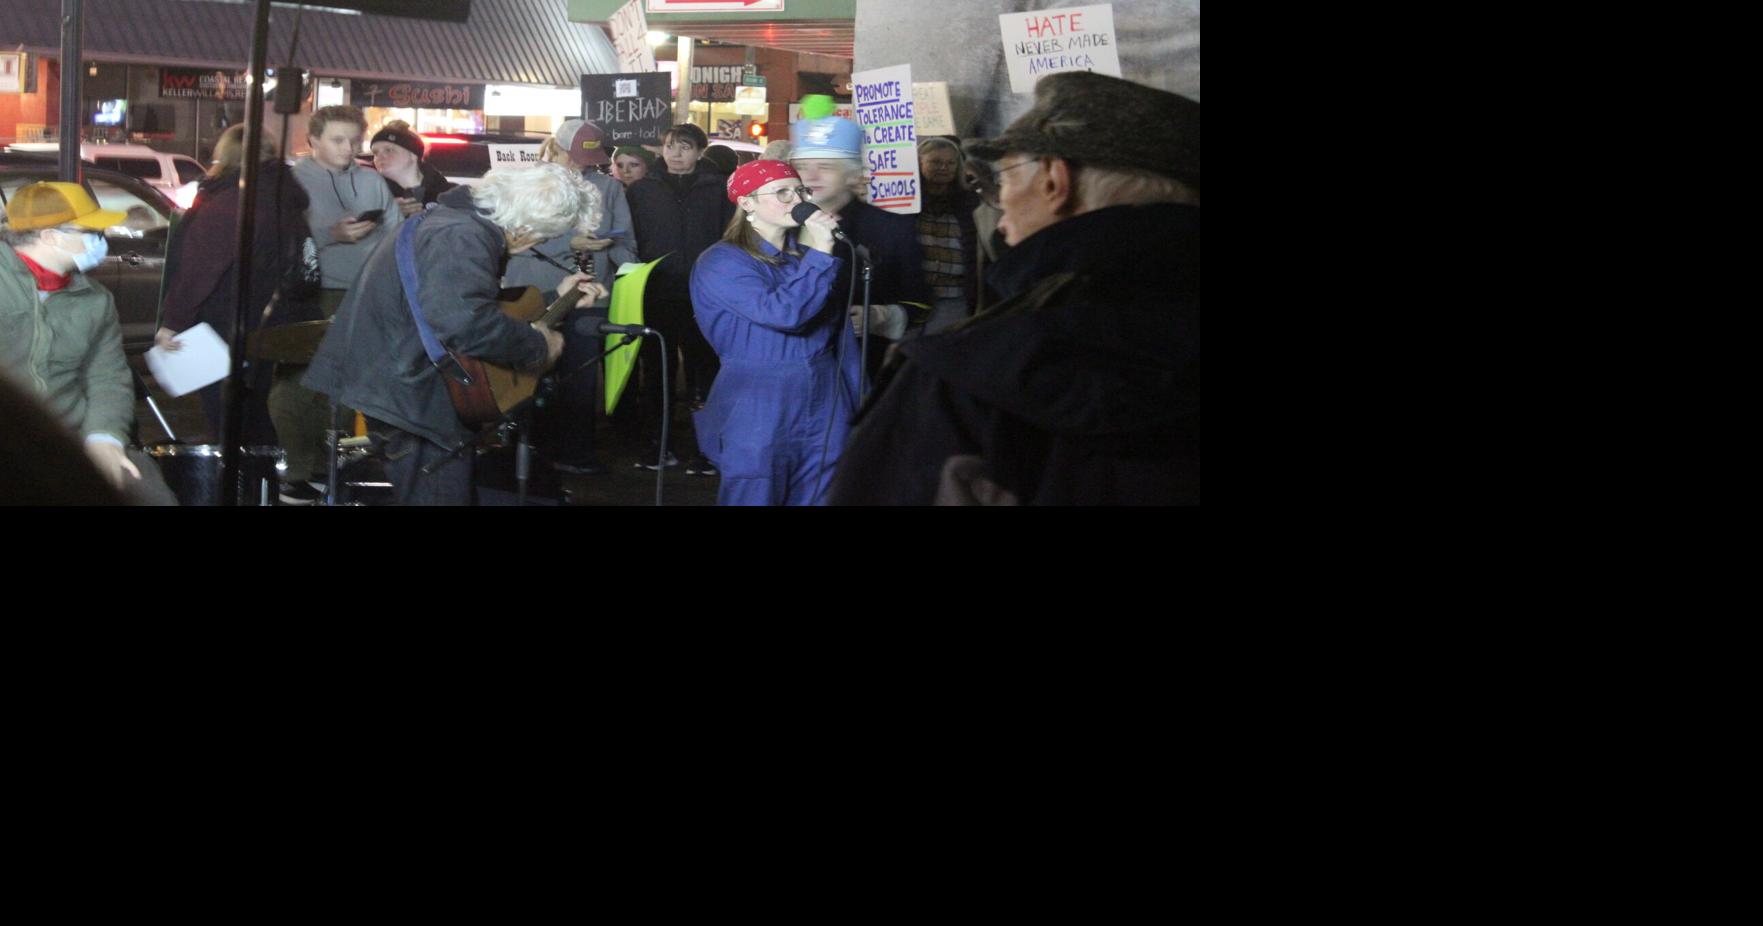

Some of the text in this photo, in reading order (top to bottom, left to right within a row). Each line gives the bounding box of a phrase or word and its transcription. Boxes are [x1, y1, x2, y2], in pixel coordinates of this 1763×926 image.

[1025, 13, 1085, 38] HATE
[1015, 33, 1109, 56] NEVER MADE
[691, 66, 745, 84] ONIGH
[1029, 54, 1095, 75] AMERICA
[855, 80, 901, 104] PROMOTE
[584, 96, 668, 124] LIBERTAD
[873, 125, 916, 145] CREATE
[496, 150, 541, 162] Back Roo
[868, 149, 898, 173] SAFE
[870, 176, 916, 200] SCHOOLS
